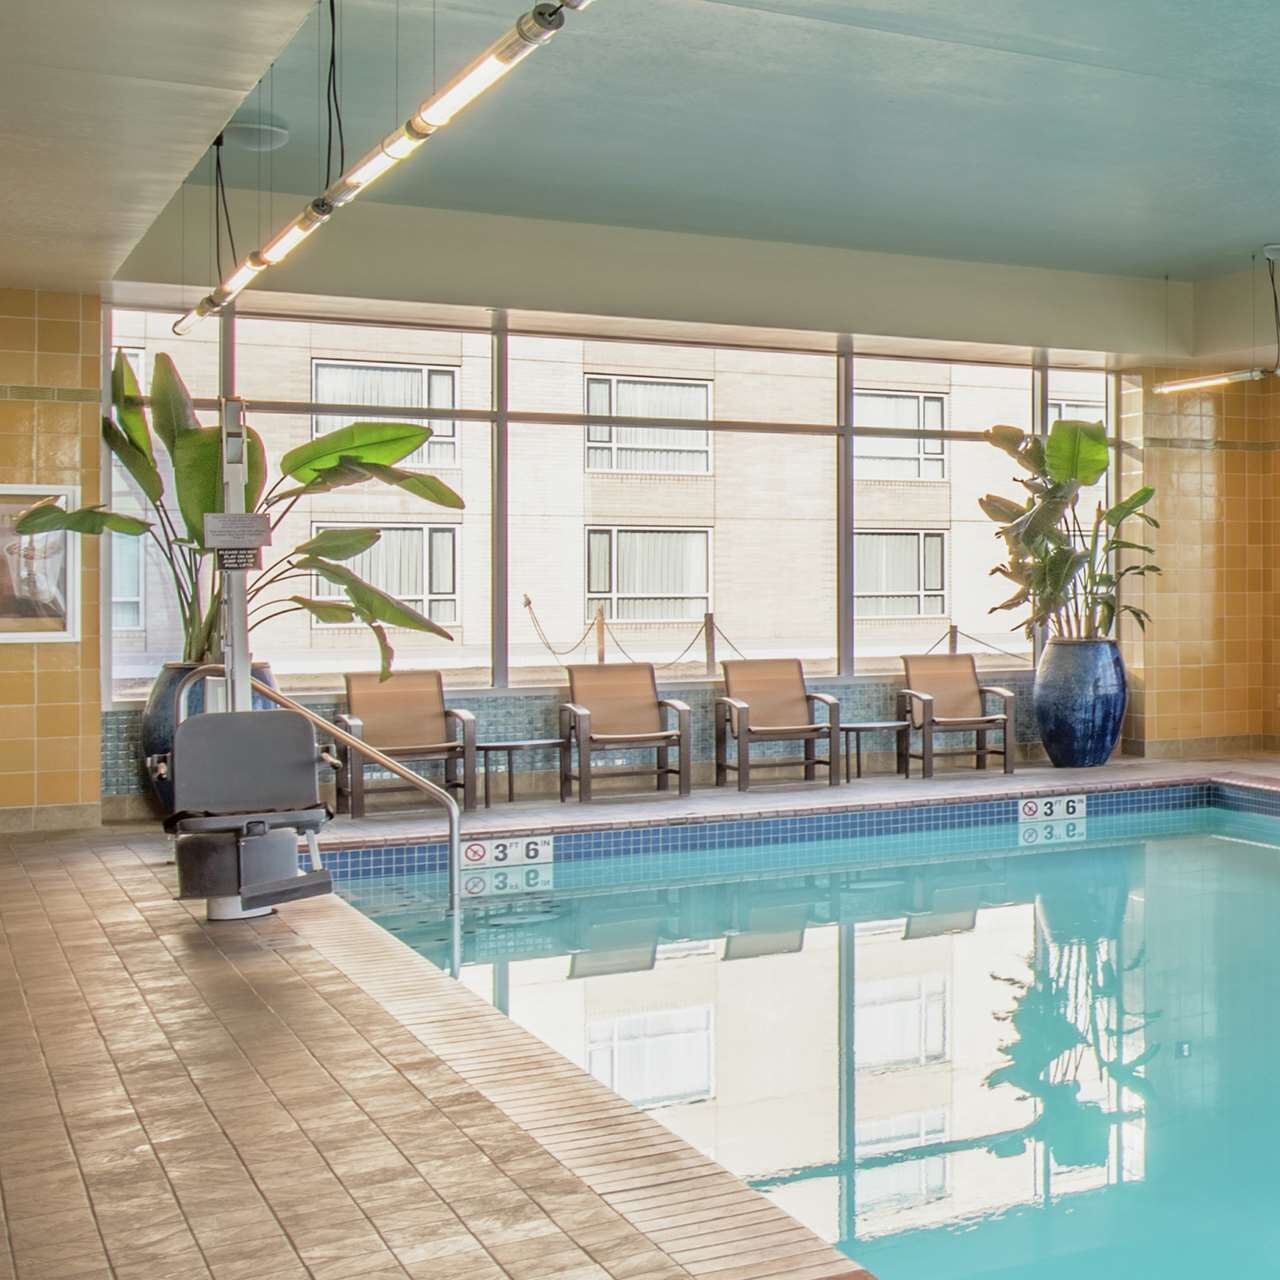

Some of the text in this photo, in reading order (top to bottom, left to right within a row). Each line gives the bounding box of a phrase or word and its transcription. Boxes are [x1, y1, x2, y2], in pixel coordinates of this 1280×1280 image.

[1043, 801, 1054, 816] 3
[1066, 799, 1076, 815] 6
[494, 843, 508, 862] 3
[525, 841, 539, 860] 6
